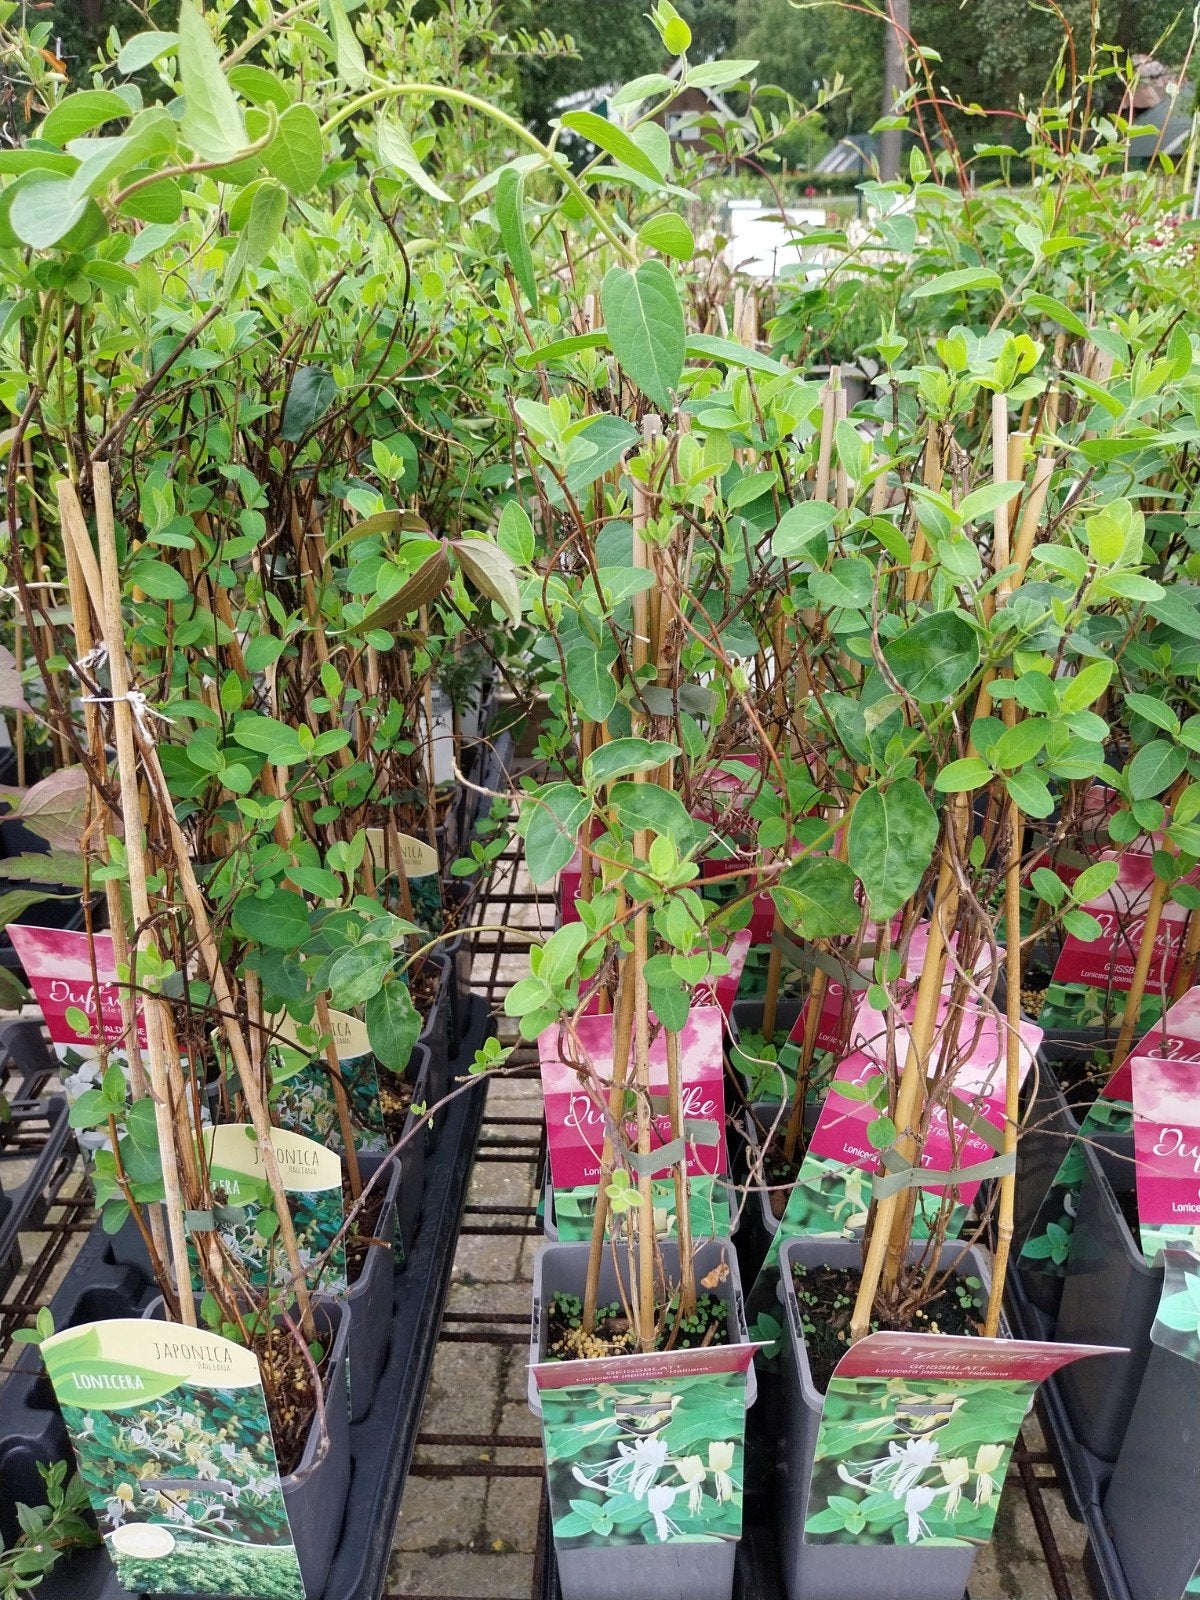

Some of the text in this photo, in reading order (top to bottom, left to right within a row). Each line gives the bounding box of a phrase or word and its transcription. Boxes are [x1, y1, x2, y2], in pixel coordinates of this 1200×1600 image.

[378, 845, 423, 859] JPNICA
[253, 1146, 320, 1166] JONICA
[153, 1342, 233, 1363] JAPONICA
[71, 1372, 145, 1390] LONICERA
